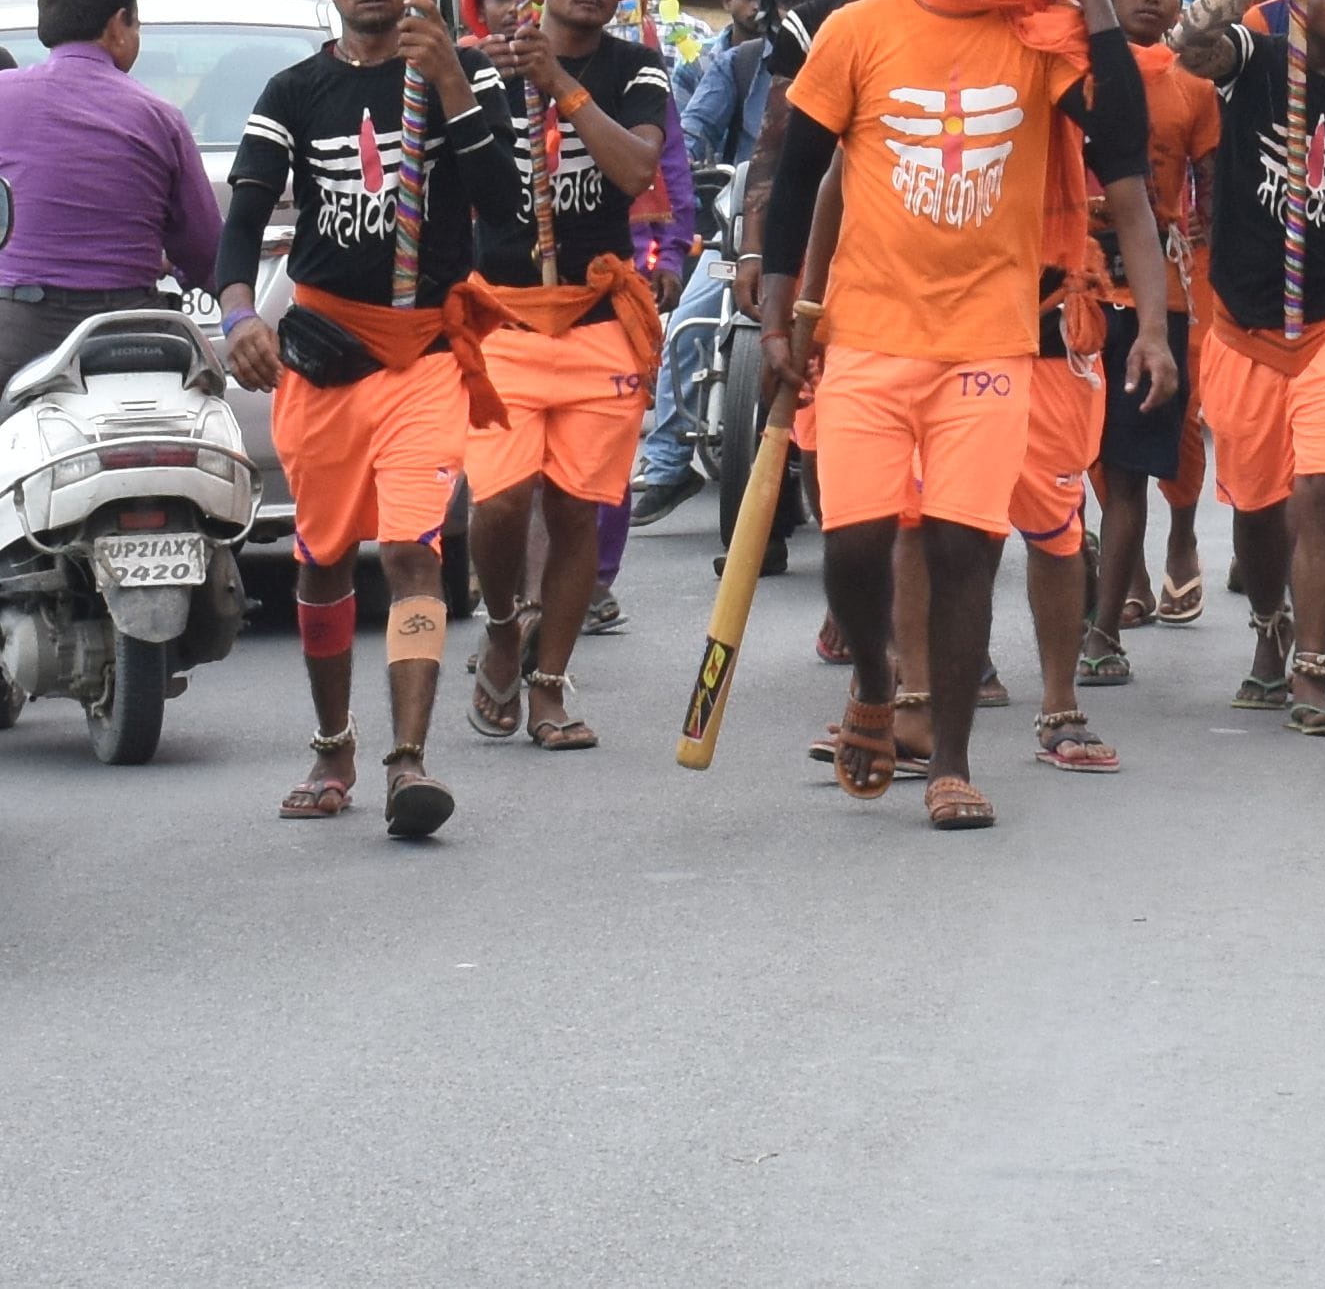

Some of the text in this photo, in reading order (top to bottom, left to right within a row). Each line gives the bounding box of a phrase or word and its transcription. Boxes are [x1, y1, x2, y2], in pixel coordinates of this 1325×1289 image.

[317, 181, 430, 249] महाक
[111, 345, 164, 358] HONDA
[609, 373, 641, 399] T9
[957, 371, 1011, 397] T90
